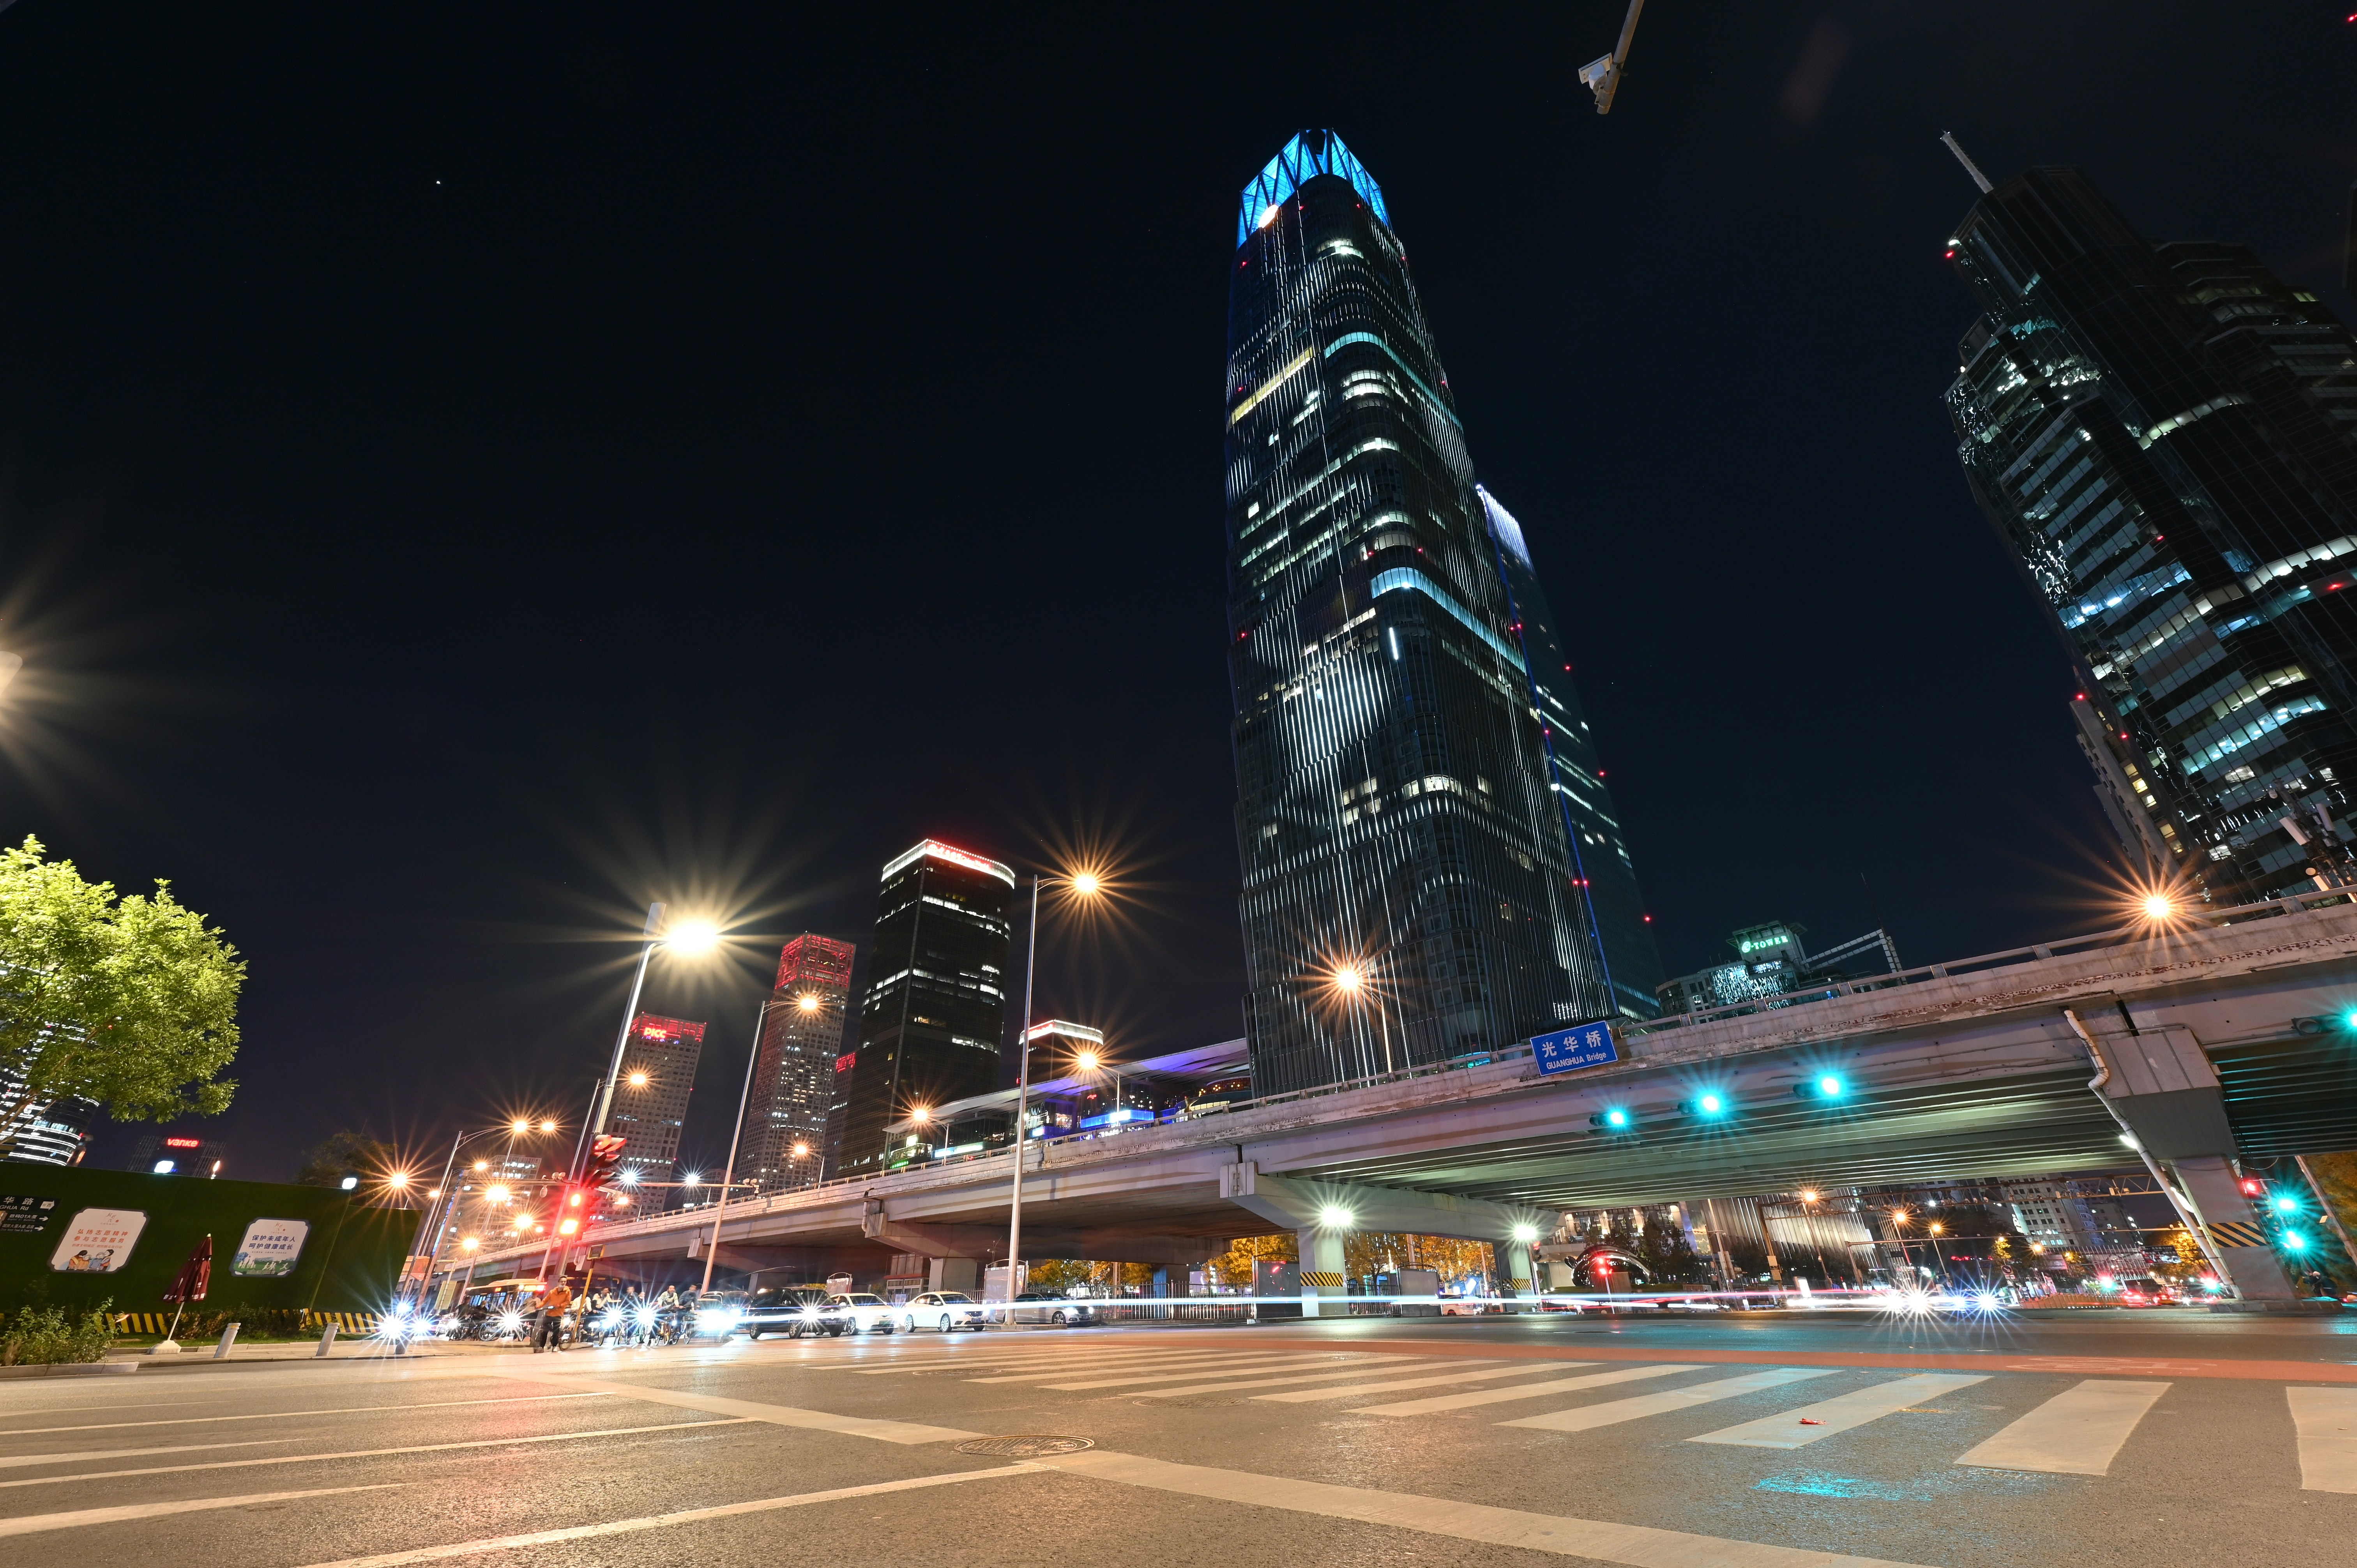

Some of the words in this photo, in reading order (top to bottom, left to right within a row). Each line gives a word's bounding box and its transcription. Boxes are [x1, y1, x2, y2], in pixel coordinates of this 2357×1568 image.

[644, 1027, 666, 1038] PICC
[1542, 1030, 1601, 1058] 光华桥
[1546, 1056, 1585, 1070] GUANGHUA
[1586, 1052, 1606, 1061] Bridge
[167, 1139, 199, 1147] vanke
